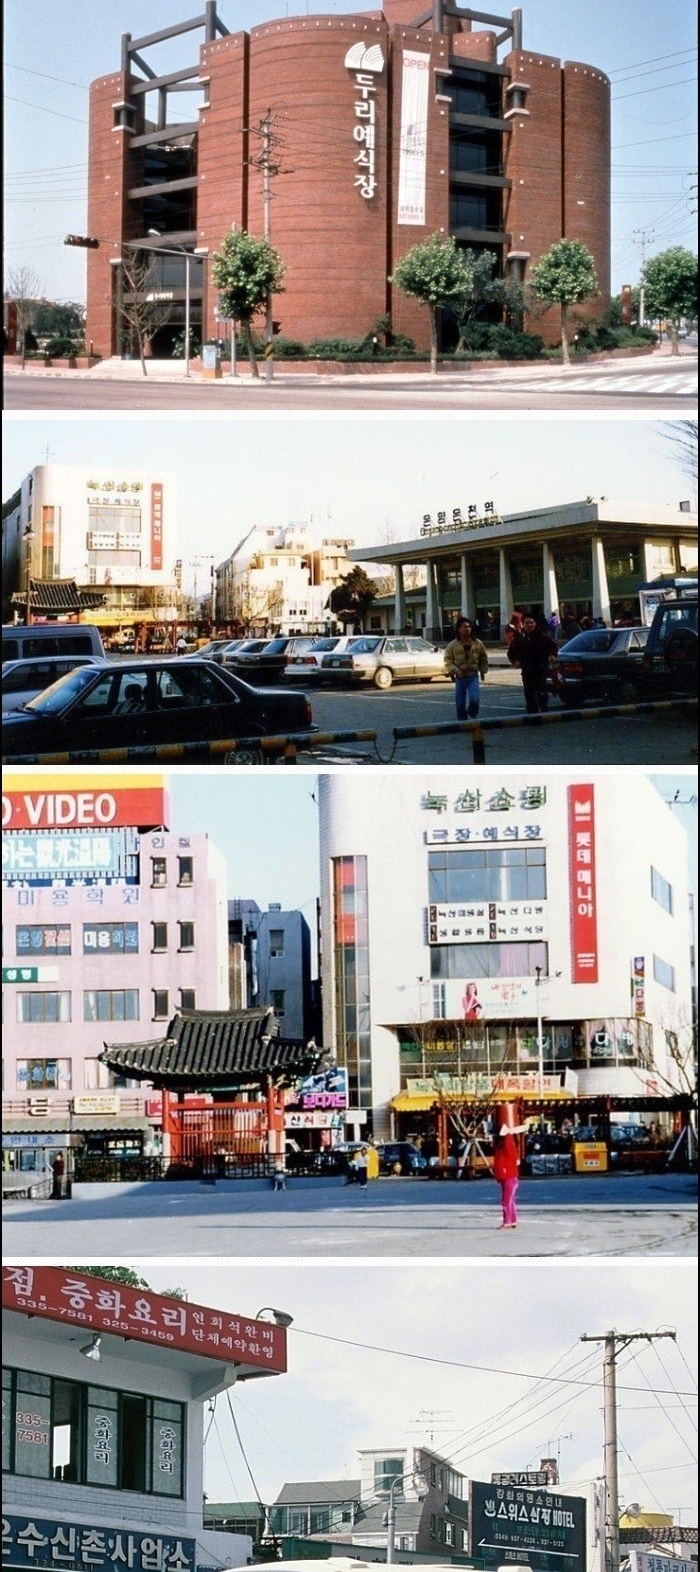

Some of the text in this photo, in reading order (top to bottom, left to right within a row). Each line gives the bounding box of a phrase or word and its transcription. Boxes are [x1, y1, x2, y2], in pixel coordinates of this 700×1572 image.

[403, 57, 429, 71] OPEN
[353, 73, 377, 199] 두리예식장
[421, 785, 547, 814] 녹산쇼핑
[18, 889, 139, 906] 미용학원
[84, 930, 138, 948] 미용학원
[303, 1093, 347, 1109] 보디가드
[17, 1297, 174, 1341] 335-7581 325-3459
[60, 1278, 187, 1336] 중화요리
[192, 1311, 274, 1342] 연회석완비
[192, 1328, 274, 1359] 단체예약환영
[16, 1412, 50, 1426] 335-
[18, 1429, 48, 1444] 7581
[94, 1415, 112, 1464] 중화요리
[160, 1427, 176, 1474] 중화요리
[553, 1510, 575, 1528] HOTEL
